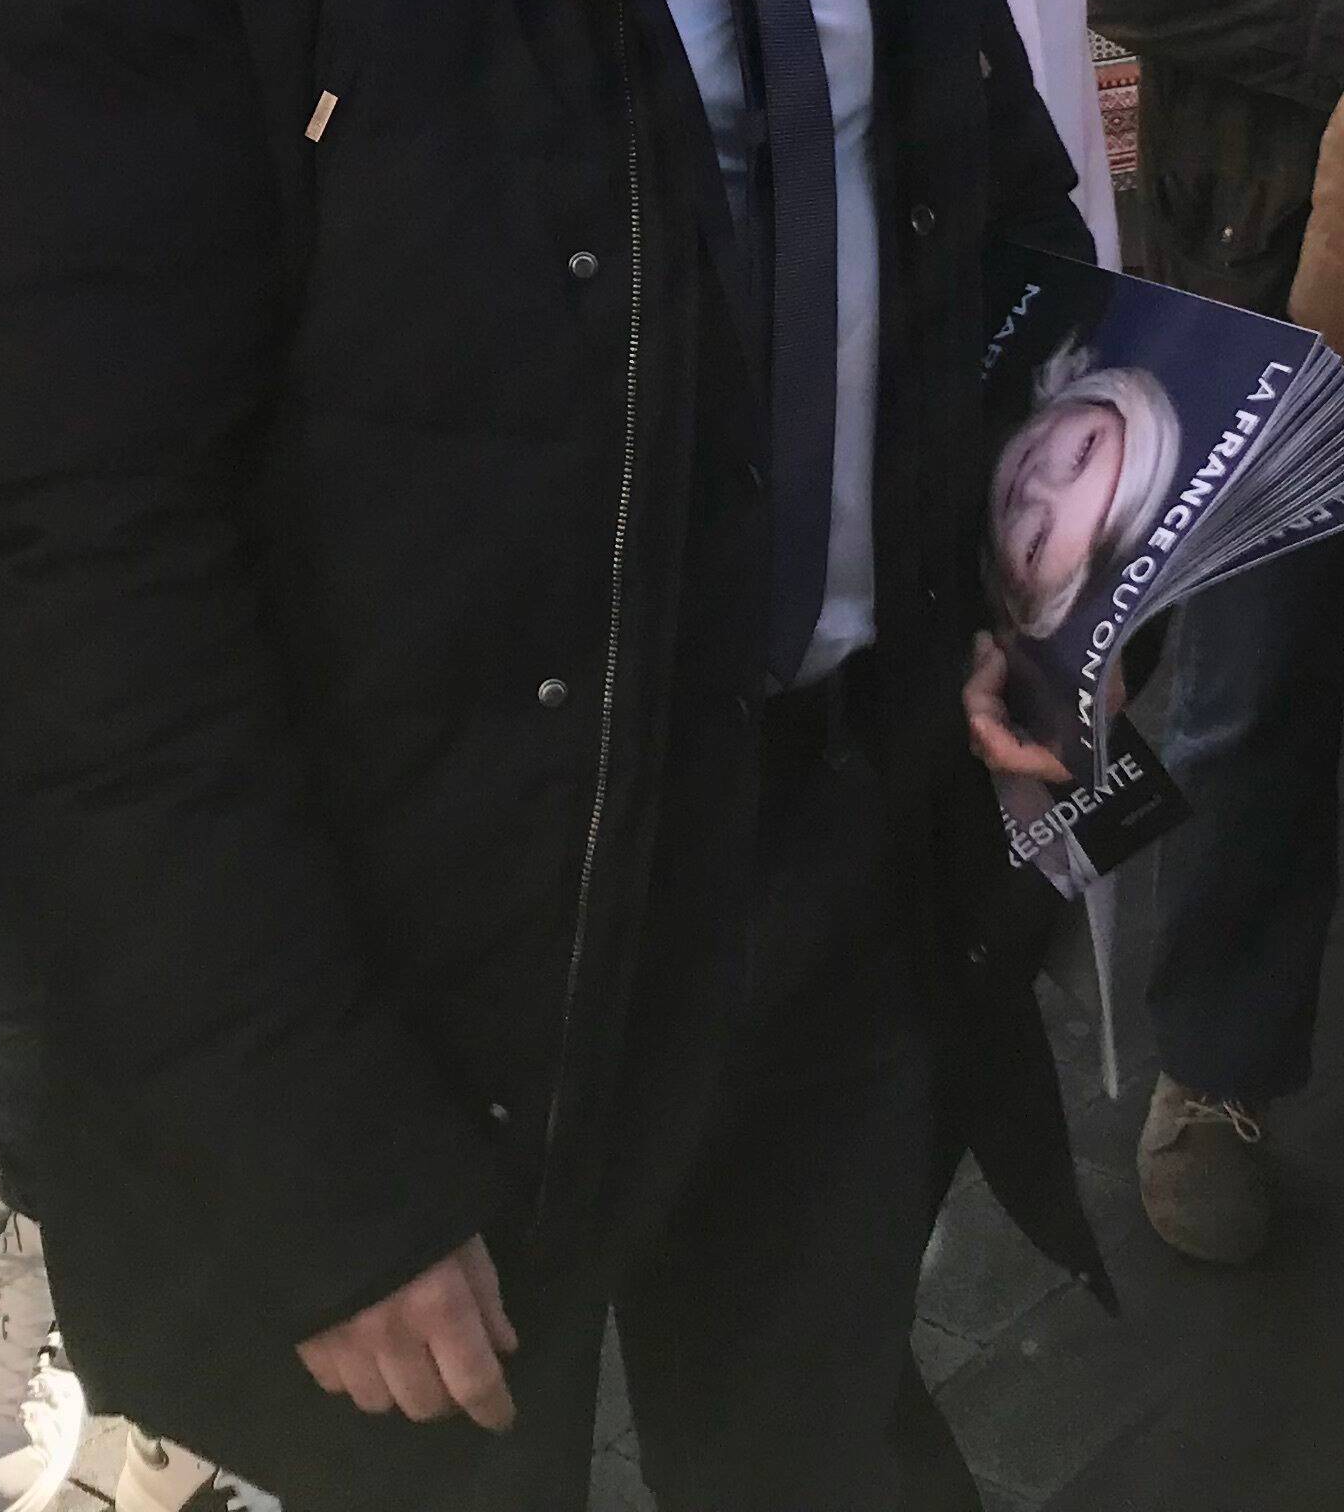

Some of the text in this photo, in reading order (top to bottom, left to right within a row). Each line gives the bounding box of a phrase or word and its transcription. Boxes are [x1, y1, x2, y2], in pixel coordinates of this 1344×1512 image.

[1246, 361, 1294, 402] LA
[1147, 409, 1261, 553] FRANCE
[1081, 554, 1156, 681] QU'ON
